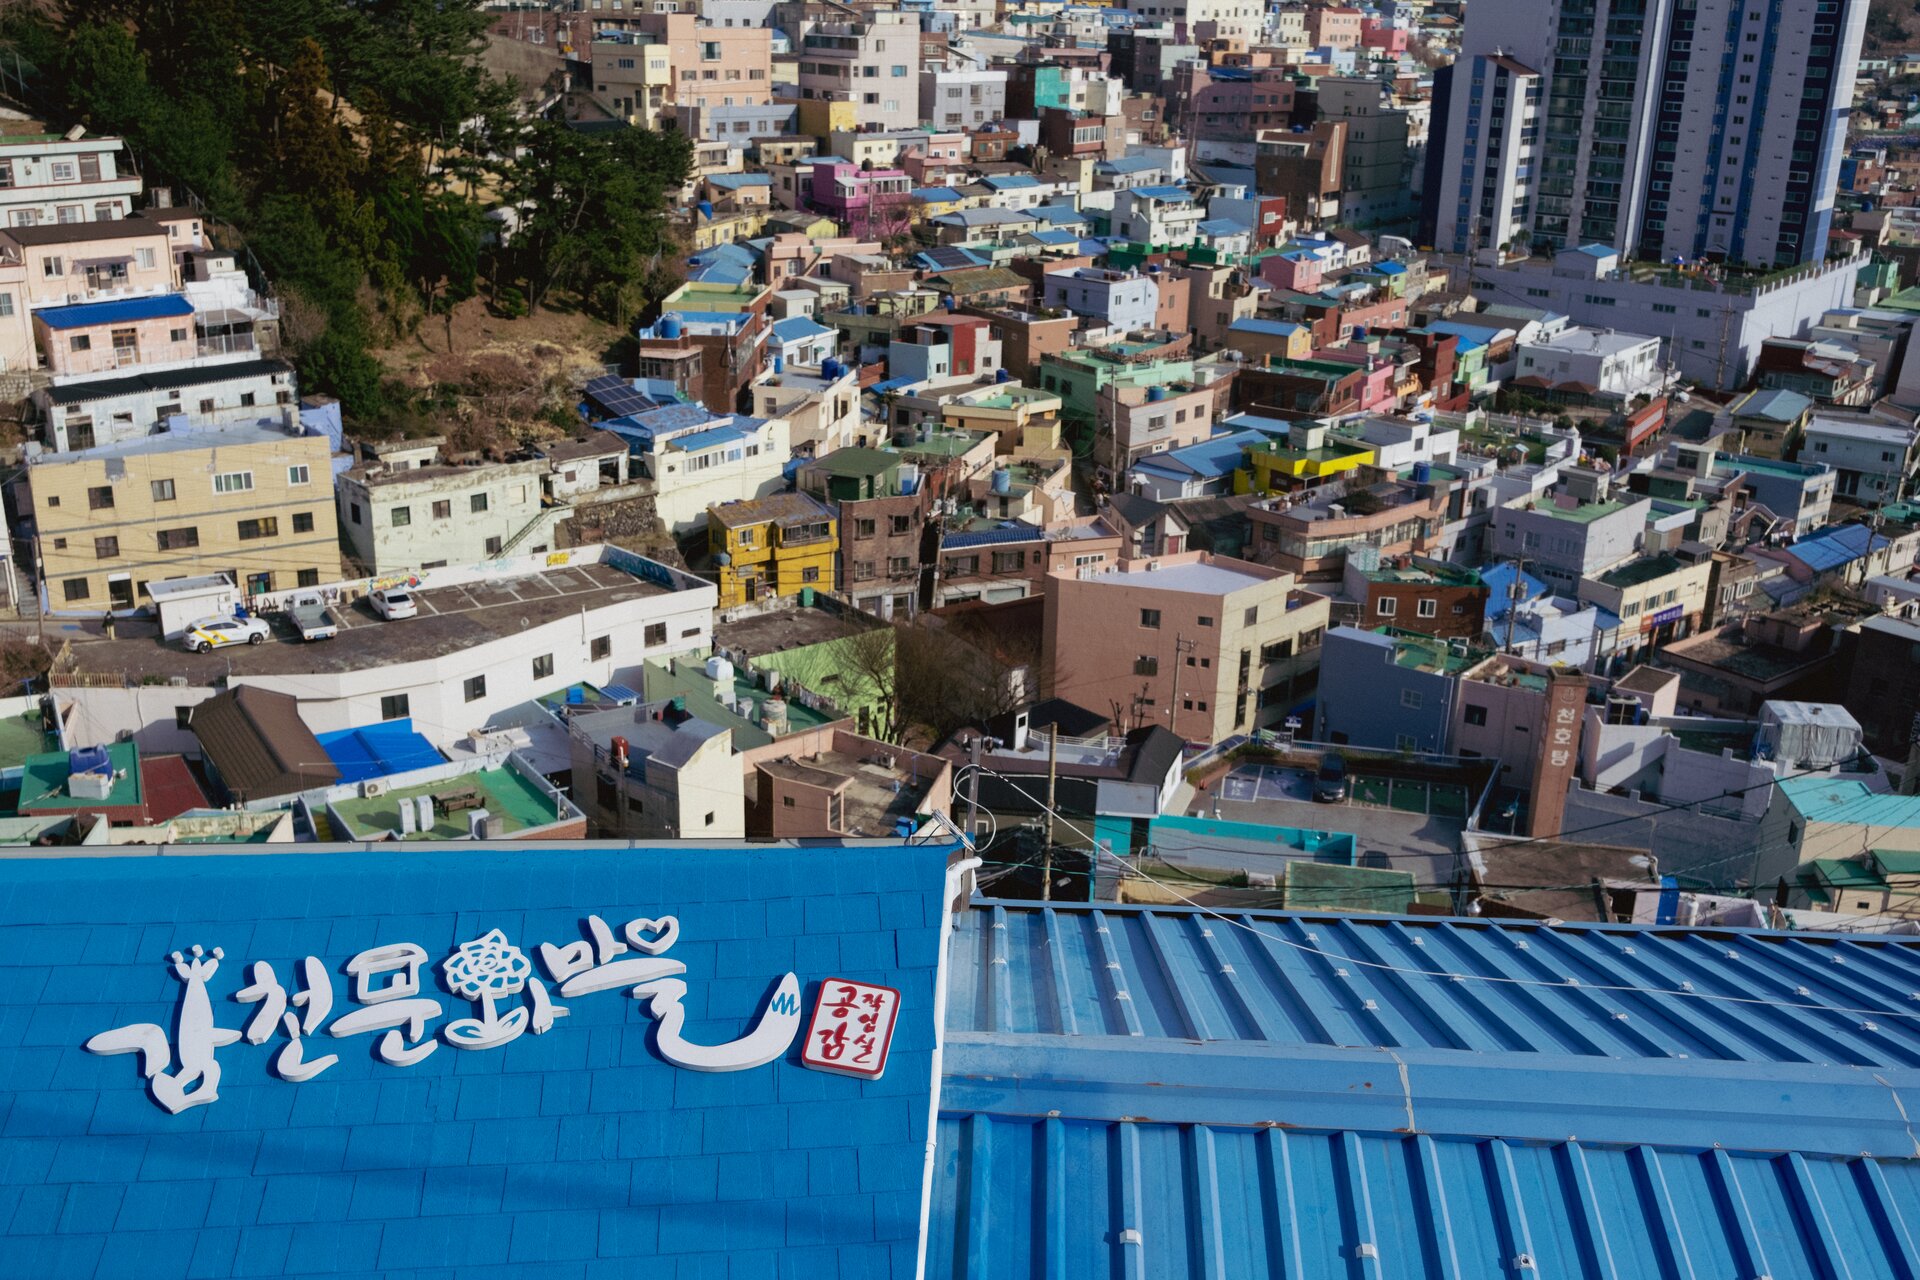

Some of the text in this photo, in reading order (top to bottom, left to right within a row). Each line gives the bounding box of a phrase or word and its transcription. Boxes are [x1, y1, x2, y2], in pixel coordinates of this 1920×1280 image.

[1551, 708, 1576, 767] 천호탕
[86, 913, 804, 1115] 감천문화마을
[816, 985, 861, 1061] 공감
[851, 993, 886, 1063] 작업실
